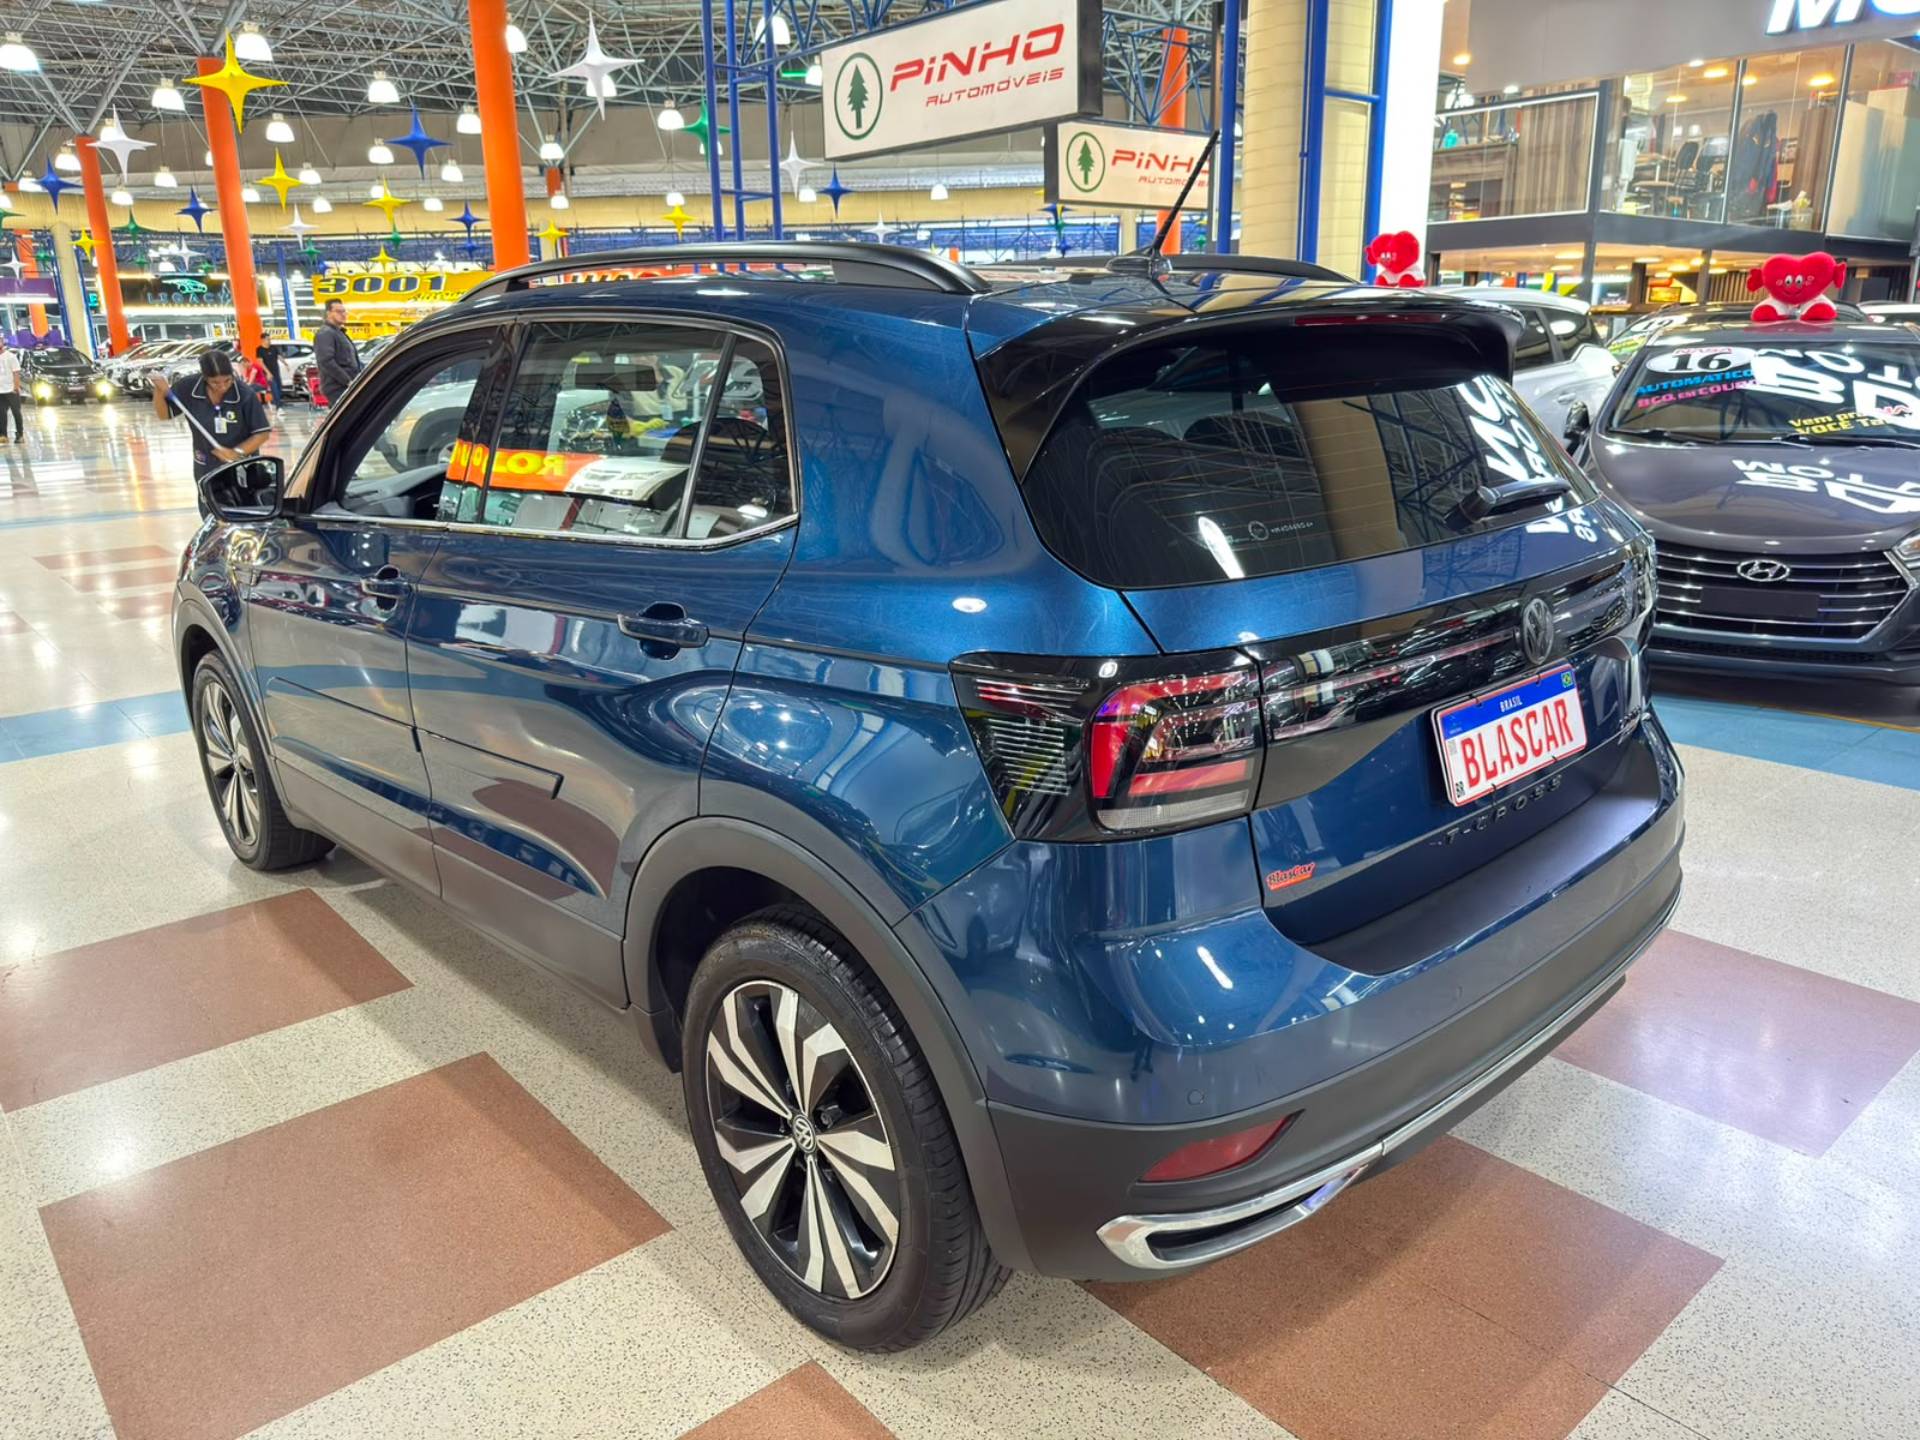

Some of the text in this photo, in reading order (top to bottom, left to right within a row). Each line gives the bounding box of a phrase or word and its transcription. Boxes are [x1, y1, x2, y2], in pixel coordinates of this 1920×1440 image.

[1111, 149, 1209, 174] PINH
[317, 275, 447, 294] 3001
[1668, 352, 1732, 372] 16
[1500, 695, 1523, 713] BRASIL
[1461, 698, 1574, 788] BLASCAR
